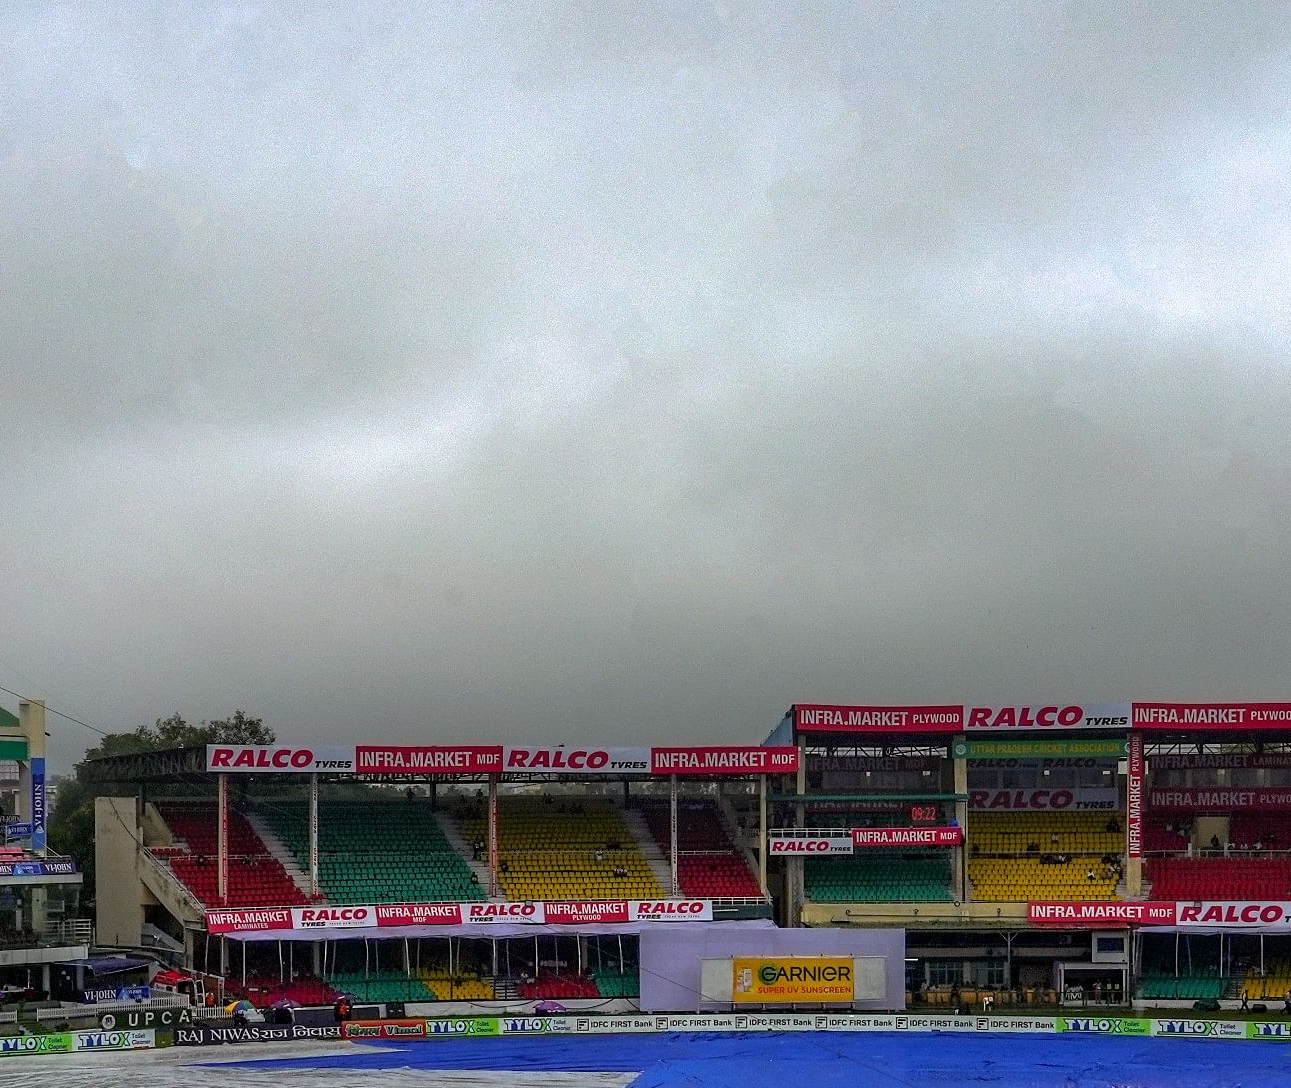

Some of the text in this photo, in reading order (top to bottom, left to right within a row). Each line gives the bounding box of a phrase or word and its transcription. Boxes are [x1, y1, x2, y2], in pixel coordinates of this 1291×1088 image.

[800, 709, 909, 727] INFRA.MARKET
[913, 713, 960, 725] PLYWOOD
[968, 706, 1084, 728] RALCO
[1085, 716, 1129, 727] TYRES
[1134, 707, 1247, 724] INFRA.MARKET
[211, 749, 796, 769] RALCO TYRES INFRA.MARKET MDF RALCO TYRES INFRA.MARKET MDF
[966, 790, 1074, 809] RALCO
[1130, 736, 1142, 855] INFRA.MARKET PLYWOOD
[32, 783, 44, 828] VI-JOHN
[911, 806, 936, 822] 09:22
[856, 831, 958, 844] INFRA.MARKET MDF
[771, 841, 829, 853] RALCO
[44, 863, 73, 874] VI-JOHN
[378, 906, 458, 918] INFRA.MARKET
[470, 904, 536, 917] RALCO
[546, 903, 626, 915] INFRA.MARKET
[637, 902, 704, 914] RALCO
[1031, 906, 1144, 919] INFRA.MARKET
[1149, 908, 1173, 918] MDF
[1180, 905, 1283, 923] RALCO
[209, 912, 289, 924] INFRA.MARKET
[301, 909, 368, 921] RALCO
[233, 922, 269, 930] LAMINATES
[761, 965, 850, 983] GARNIER
[84, 990, 117, 1003] VI-JOHN
[757, 986, 851, 994] SUPER UV SUNSCREEN
[503, 1018, 552, 1034] TYLOX
[591, 1019, 653, 1028] IDFC FIRST Bank
[829, 1018, 892, 1027] IDFC FIRST Bank
[990, 1020, 1054, 1030] IDFC FIRST Bank
[1063, 1018, 1122, 1033] TYLOX
[1158, 1020, 1218, 1036] TYLOX
[177, 1026, 260, 1046] RAJ NIWAS
[260, 1022, 340, 1040] राज निवास
[78, 1031, 131, 1047] TYLOX
